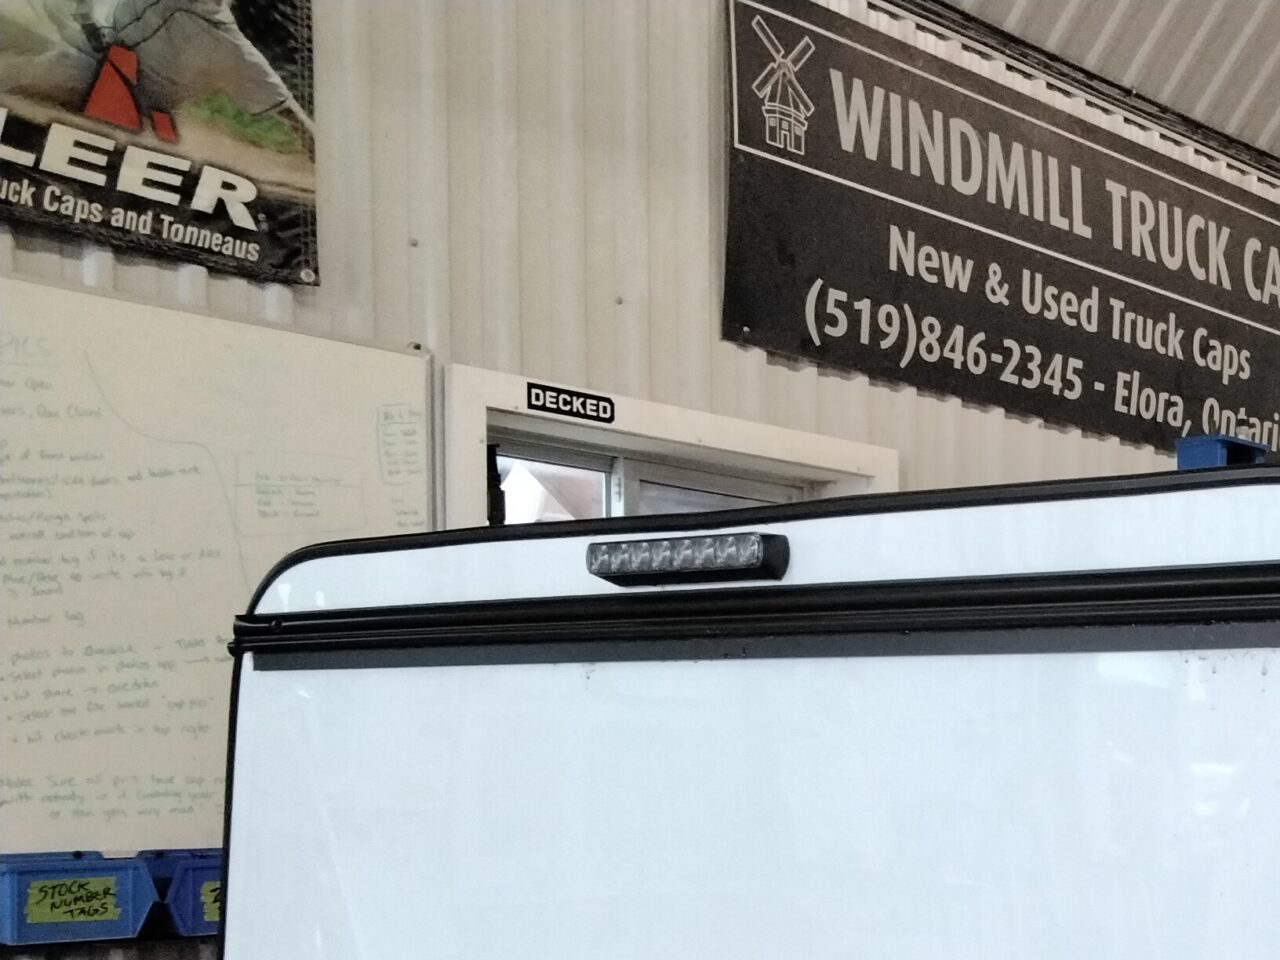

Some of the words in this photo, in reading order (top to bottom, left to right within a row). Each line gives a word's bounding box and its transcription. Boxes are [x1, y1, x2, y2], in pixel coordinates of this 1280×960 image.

[0, 108, 260, 232] LEER
[830, 68, 1092, 239] WINDMILL
[1105, 179, 1231, 291] TRUCK
[43, 185, 103, 223] Caps
[111, 207, 152, 234] and
[160, 214, 261, 262] Tonneaus
[889, 224, 974, 293] New
[985, 262, 1009, 306] &
[1022, 268, 1099, 333] Used
[1110, 297, 1184, 361] Truck
[1193, 327, 1251, 386] Caps
[805, 277, 1083, 400] (519)846-2345
[1114, 370, 1192, 438] Elora,
[531, 388, 612, 418] DECKED
[36, 880, 91, 905] STOCK
[50, 886, 116, 913] NUMBER
[63, 902, 110, 920] TAGS
